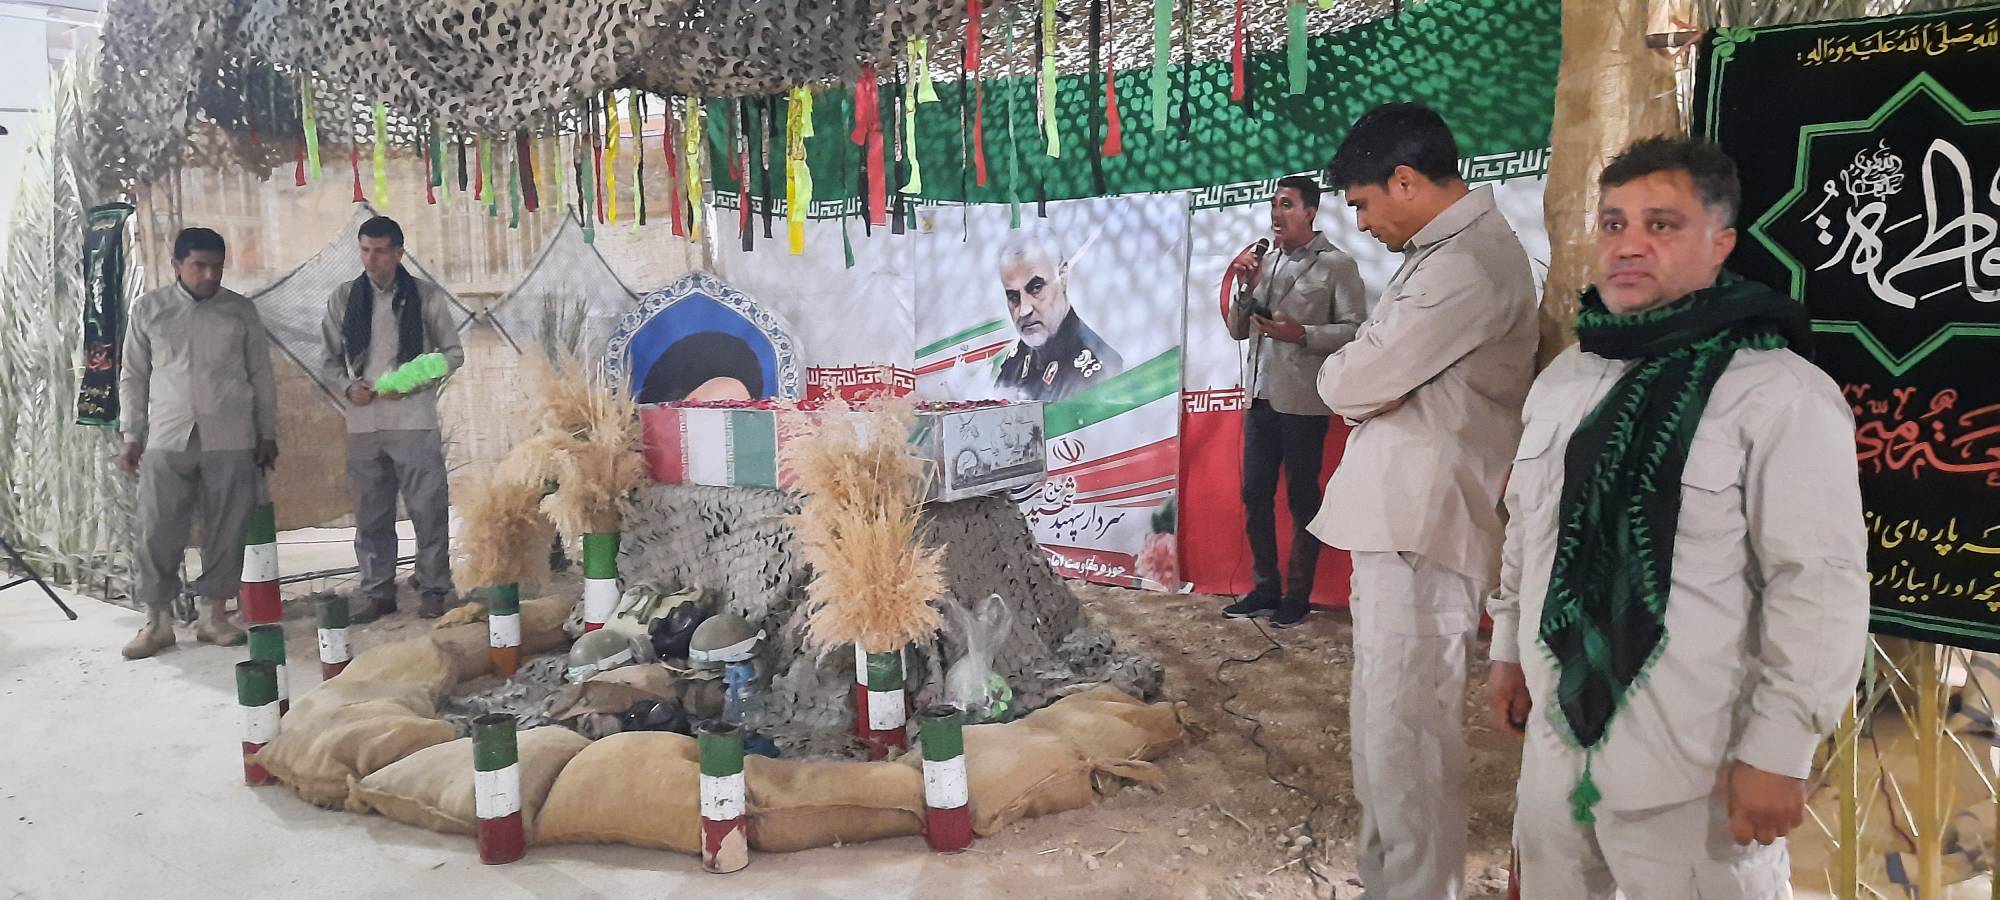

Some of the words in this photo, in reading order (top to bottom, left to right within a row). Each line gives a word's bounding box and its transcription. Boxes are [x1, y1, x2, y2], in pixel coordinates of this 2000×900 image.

[1025, 477, 1075, 526] شهید
[1044, 482, 1063, 502] حاج
[1048, 510, 1085, 542] سپهبد
[1081, 504, 1126, 540] سردار
